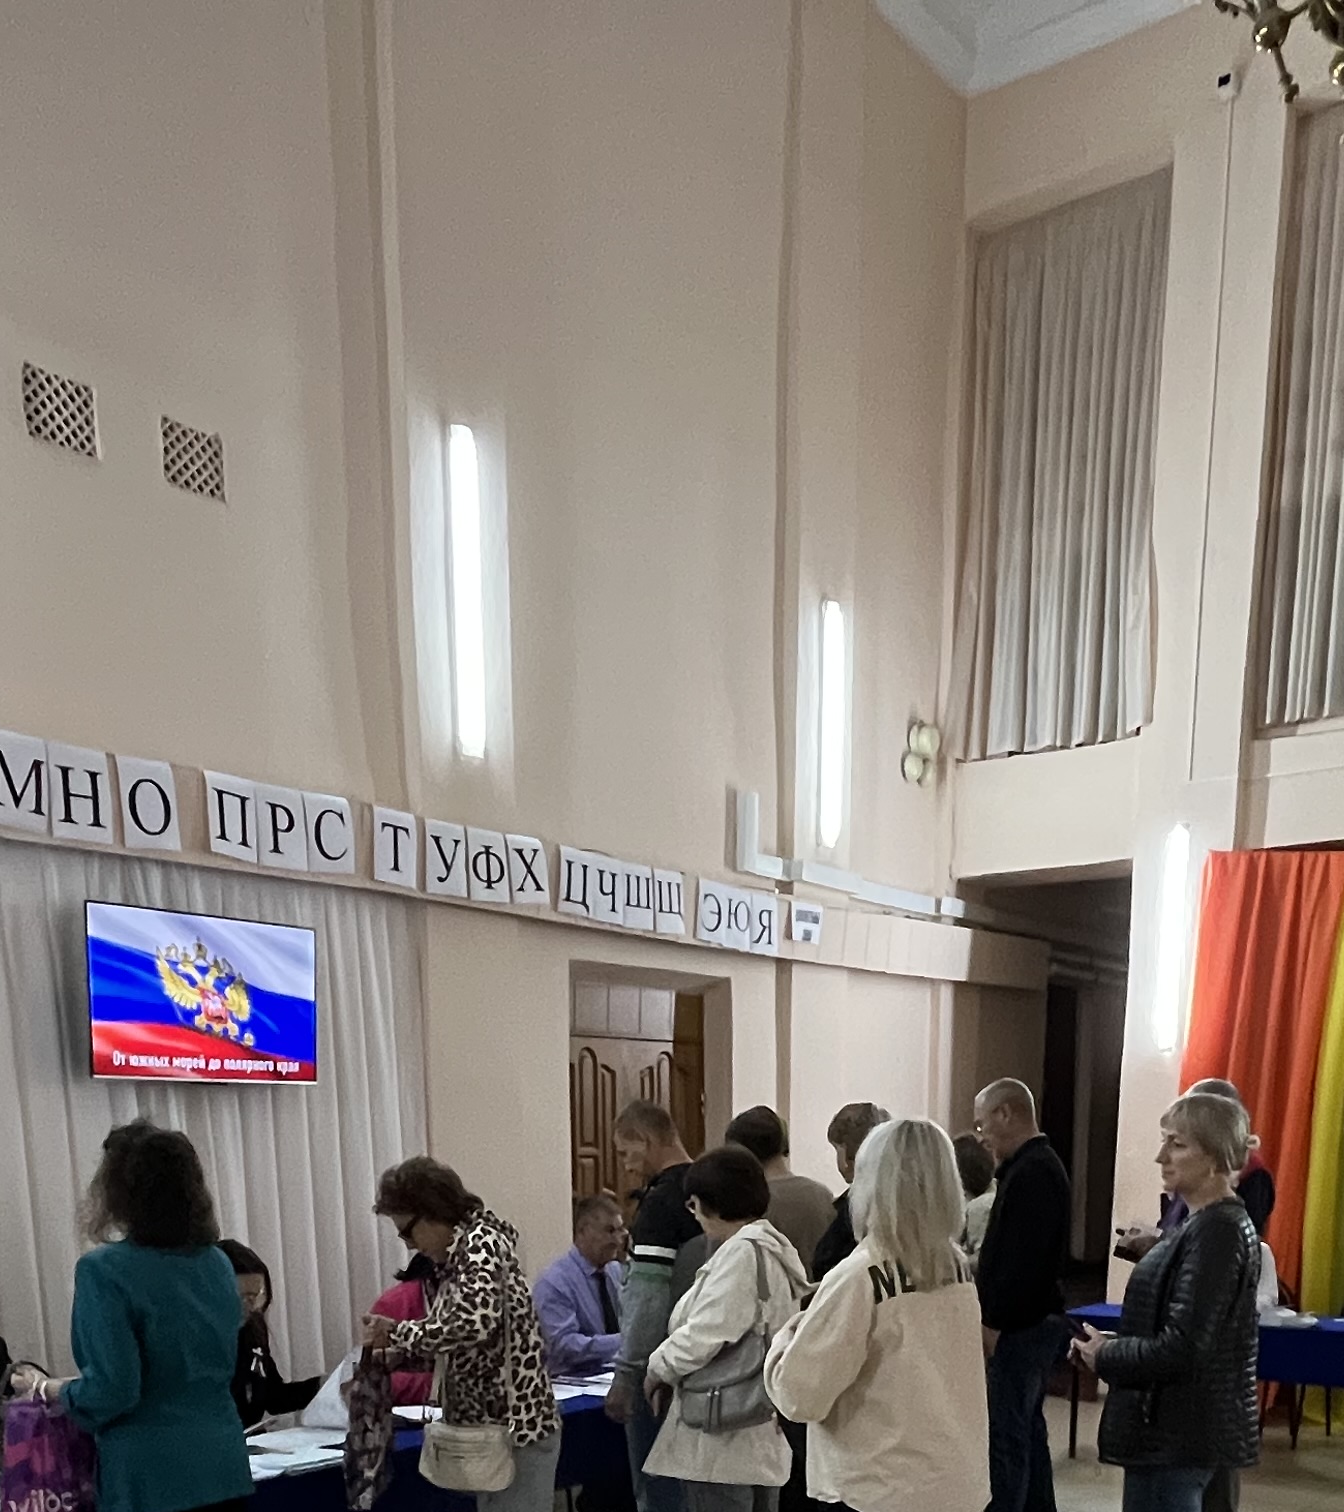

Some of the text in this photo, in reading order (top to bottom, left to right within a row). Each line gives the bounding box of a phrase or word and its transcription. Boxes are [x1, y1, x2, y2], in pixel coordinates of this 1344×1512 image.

[112, 1050, 127, 1067] От
[128, 1055, 170, 1068] южных
[172, 1054, 206, 1072] морей
[207, 1058, 222, 1071] до
